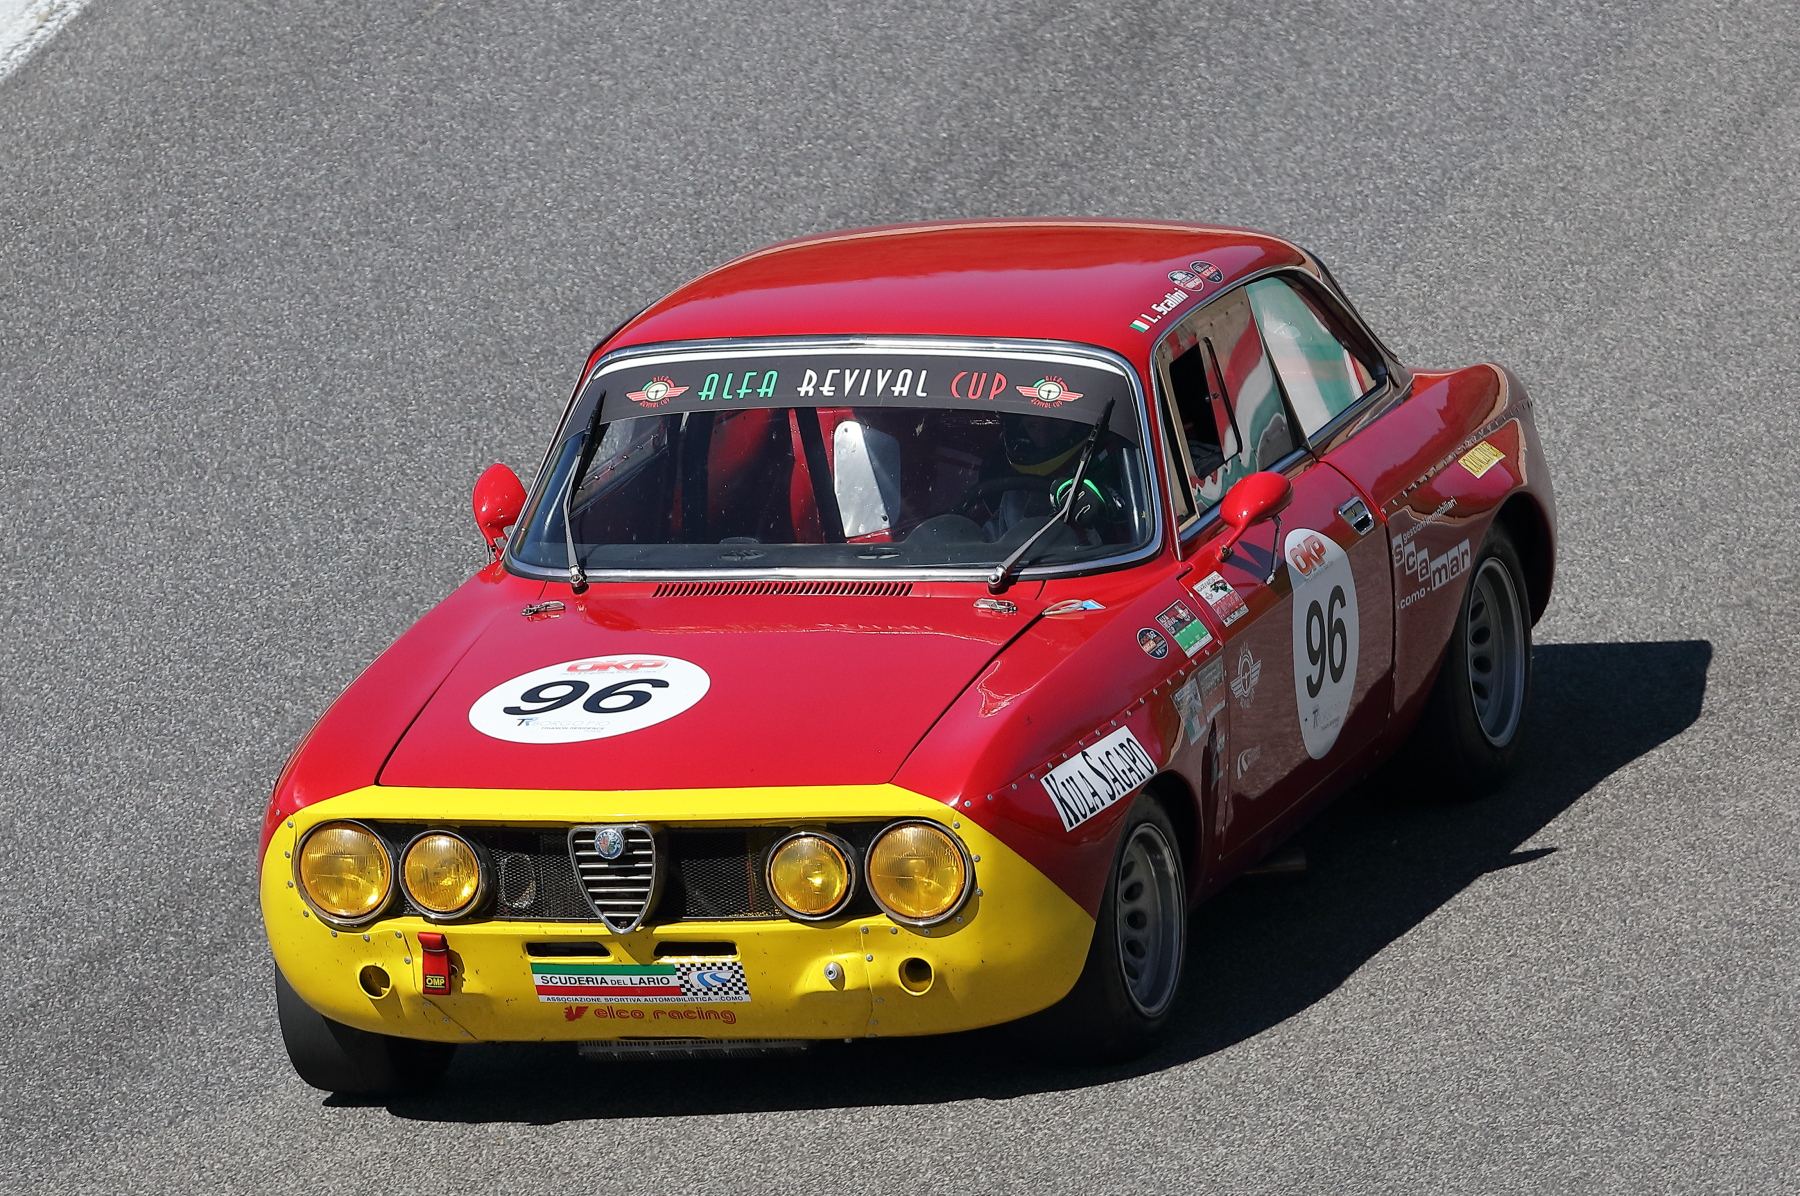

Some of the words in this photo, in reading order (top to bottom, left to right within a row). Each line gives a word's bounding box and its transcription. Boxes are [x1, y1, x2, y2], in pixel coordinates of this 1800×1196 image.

[1151, 287, 1190, 316] Scalini
[697, 370, 779, 401] ALFA
[796, 368, 928, 398] REVIVAL
[951, 371, 1008, 400] CUP
[1289, 534, 1327, 577] OKP
[1393, 539, 1470, 590] scamar
[1306, 585, 1347, 699] 96
[566, 659, 666, 672] OKP
[503, 678, 670, 716] 96
[1044, 770, 1105, 828] KULA
[1081, 737, 1155, 801] SAGAPO
[426, 977, 445, 986] OMP
[540, 975, 609, 986] SCUDERIA
[629, 976, 671, 986] LARIO
[653, 1006, 737, 1025] racing
